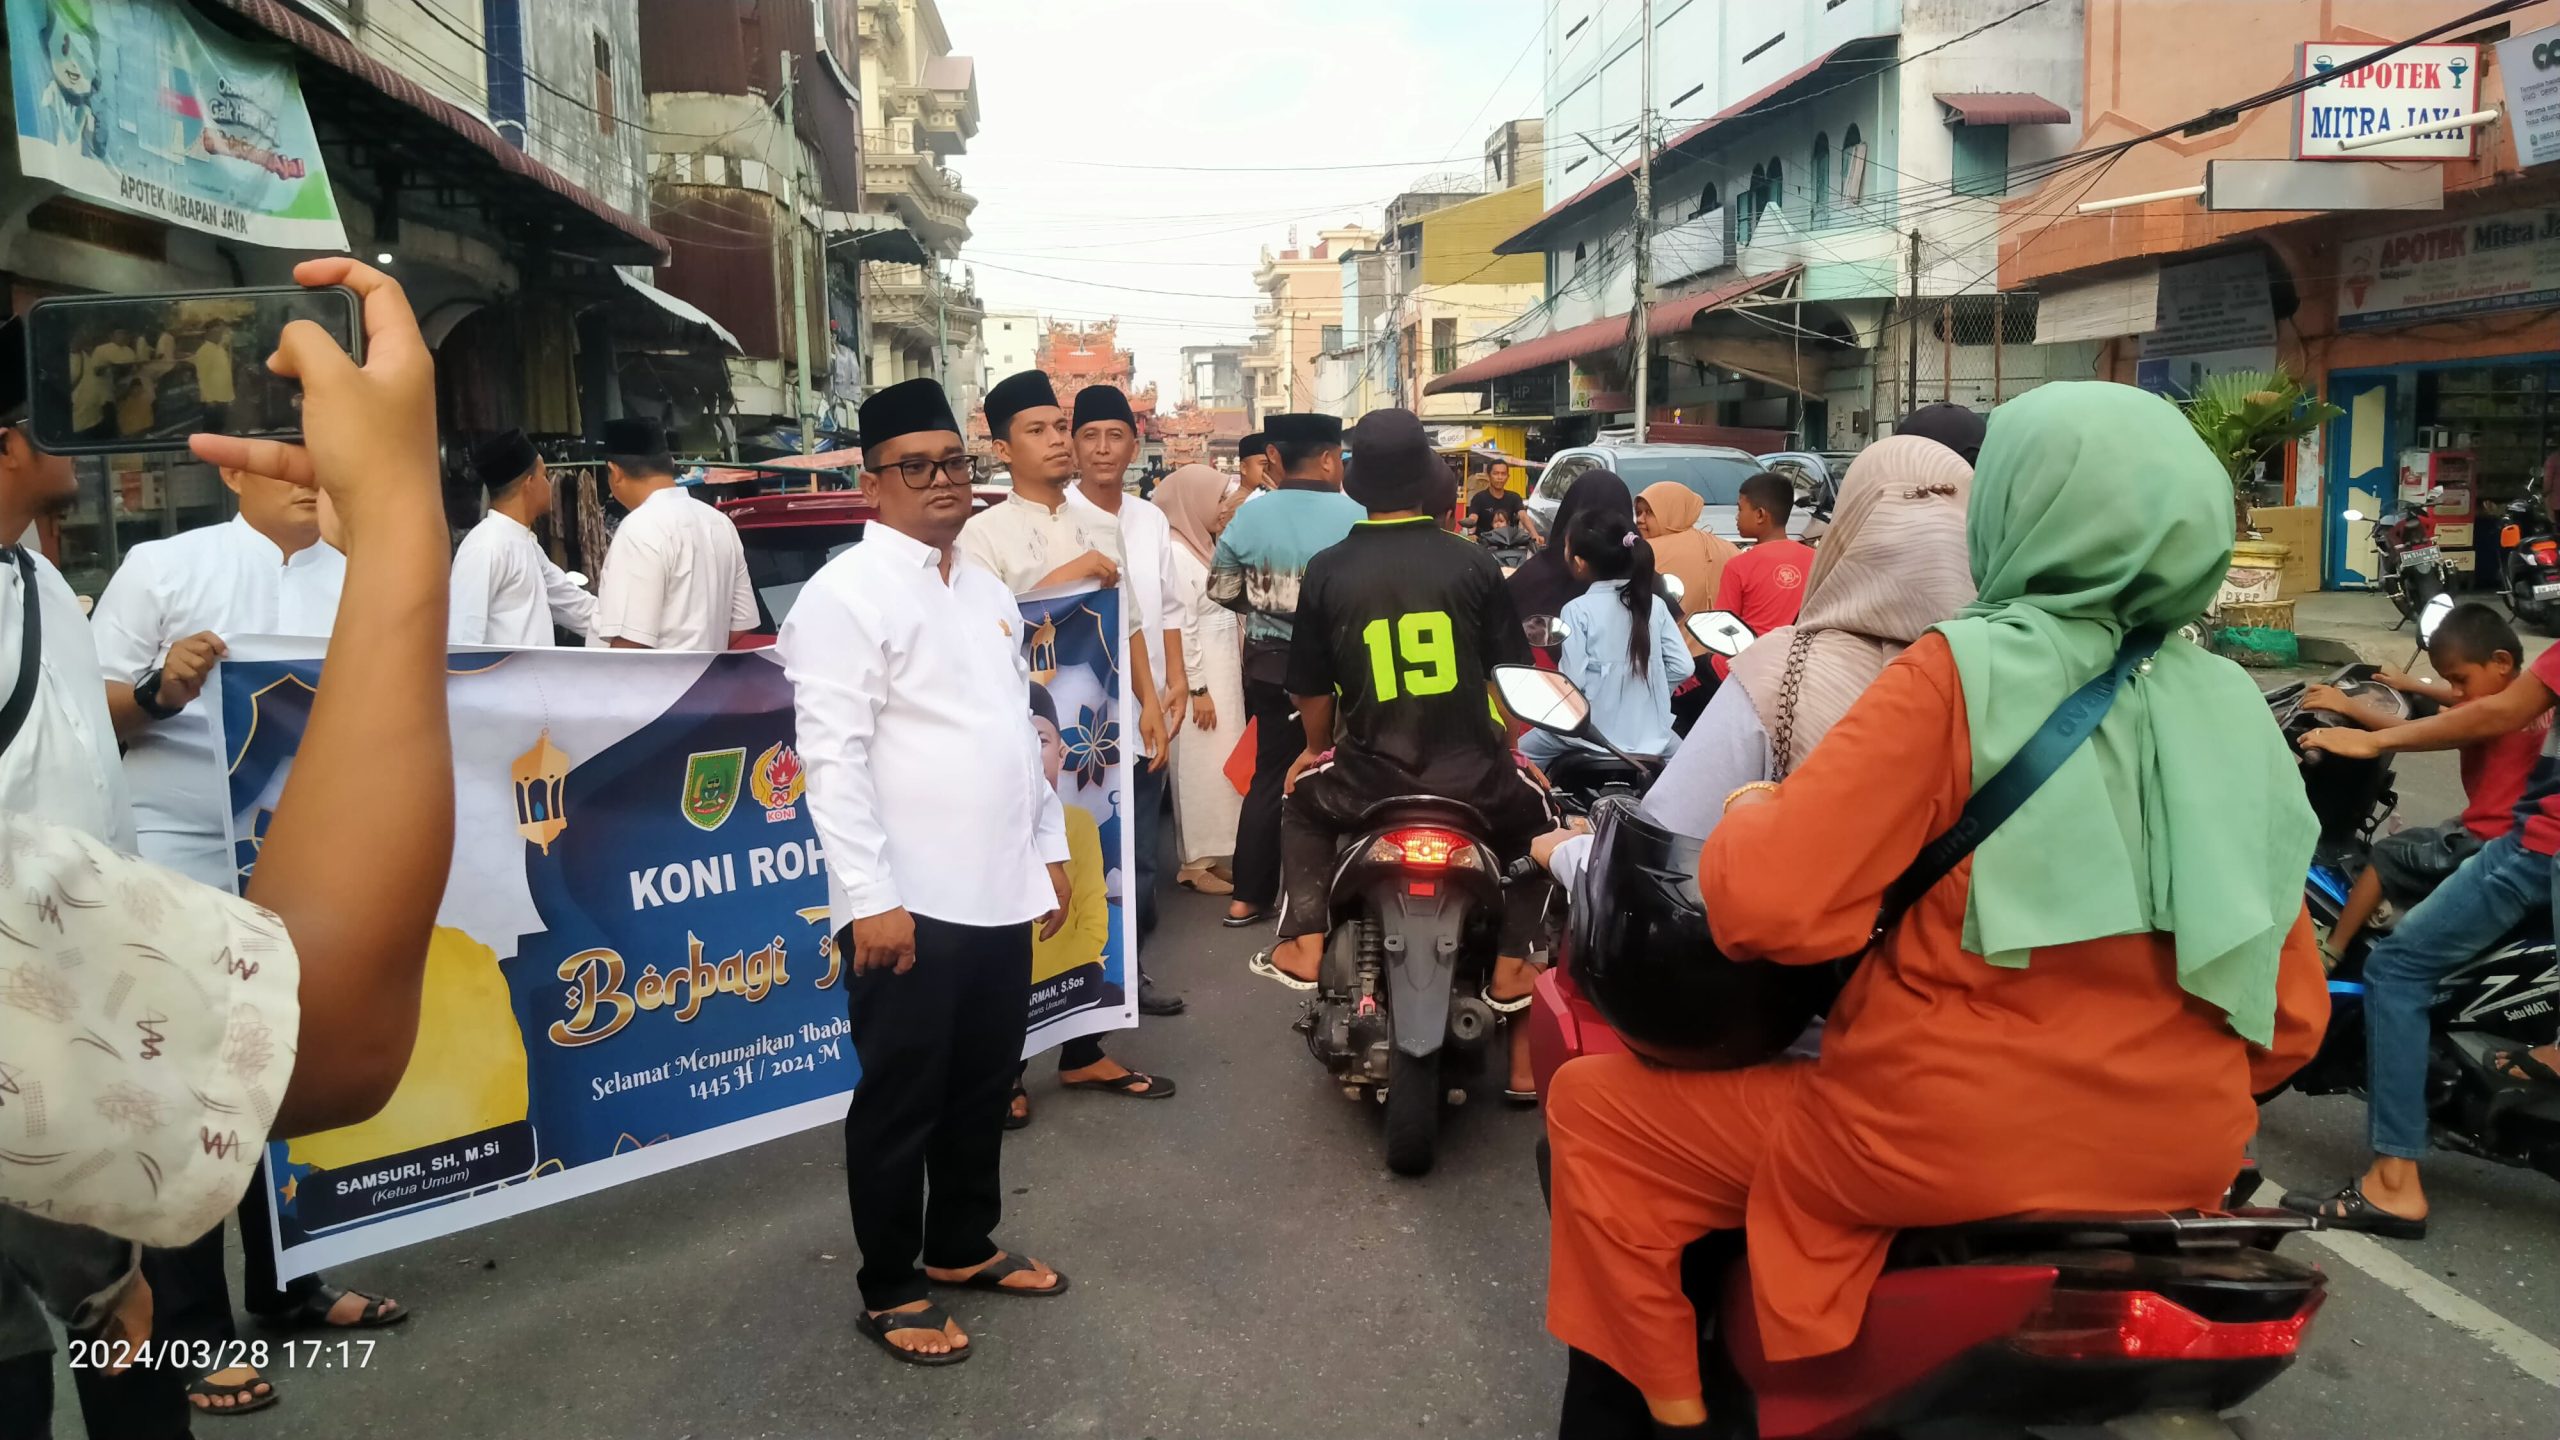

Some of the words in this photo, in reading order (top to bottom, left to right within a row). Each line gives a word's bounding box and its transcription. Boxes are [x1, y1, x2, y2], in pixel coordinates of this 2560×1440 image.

[2340, 62, 2441, 89] APOTEK
[2311, 106, 2391, 138] MITRA
[120, 174, 166, 211] APOTEK
[167, 191, 218, 227] HARAPAN
[220, 207, 248, 235] JAYA
[2380, 226, 2467, 269] APOTEK
[2474, 221, 2535, 251] Mitra
[2225, 591, 2260, 601] DKPP
[1362, 610, 1459, 702] 19
[766, 808, 797, 822] KONI
[629, 853, 737, 911] KONI
[548, 930, 791, 1047] Berbagi
[1060, 976, 1085, 994] S.Sos
[2503, 1009, 2526, 1022] Satu
[591, 1062, 671, 1101] Selamat
[674, 1033, 795, 1077] Menunaikan
[688, 1075, 731, 1100] 1445
[733, 1057, 755, 1091] H
[770, 1053, 816, 1077] 2024
[818, 1036, 842, 1065] M
[336, 1162, 426, 1195] SAMSURI,
[431, 1153, 460, 1171] SH,
[464, 1140, 500, 1163] M.Si
[372, 1182, 418, 1206] (Ketua
[421, 1167, 470, 1192] Umum)
